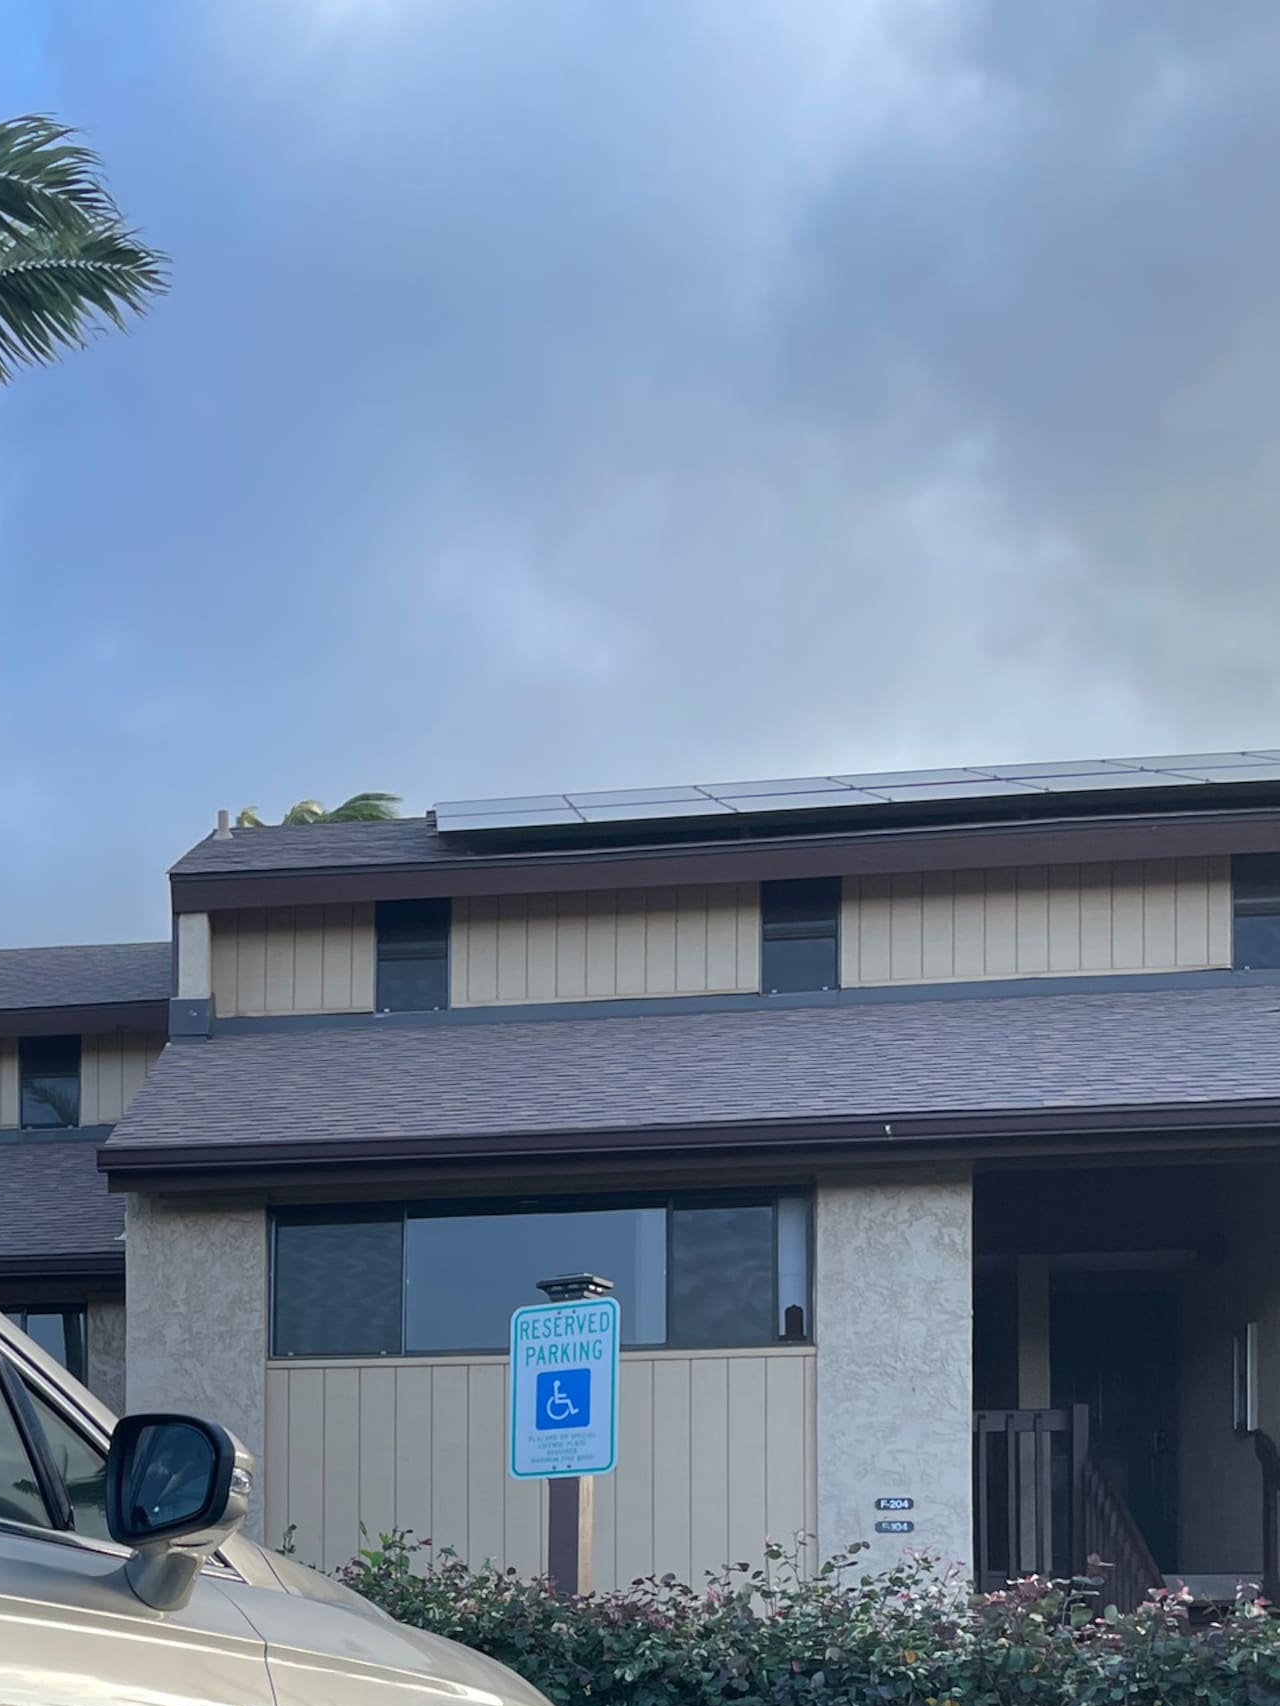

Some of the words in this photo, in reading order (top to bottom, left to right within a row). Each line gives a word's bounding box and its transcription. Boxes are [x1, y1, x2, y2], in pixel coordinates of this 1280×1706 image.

[519, 1310, 610, 1341] RESERVED
[525, 1339, 603, 1366] PARKING
[880, 1499, 909, 1508] F-204
